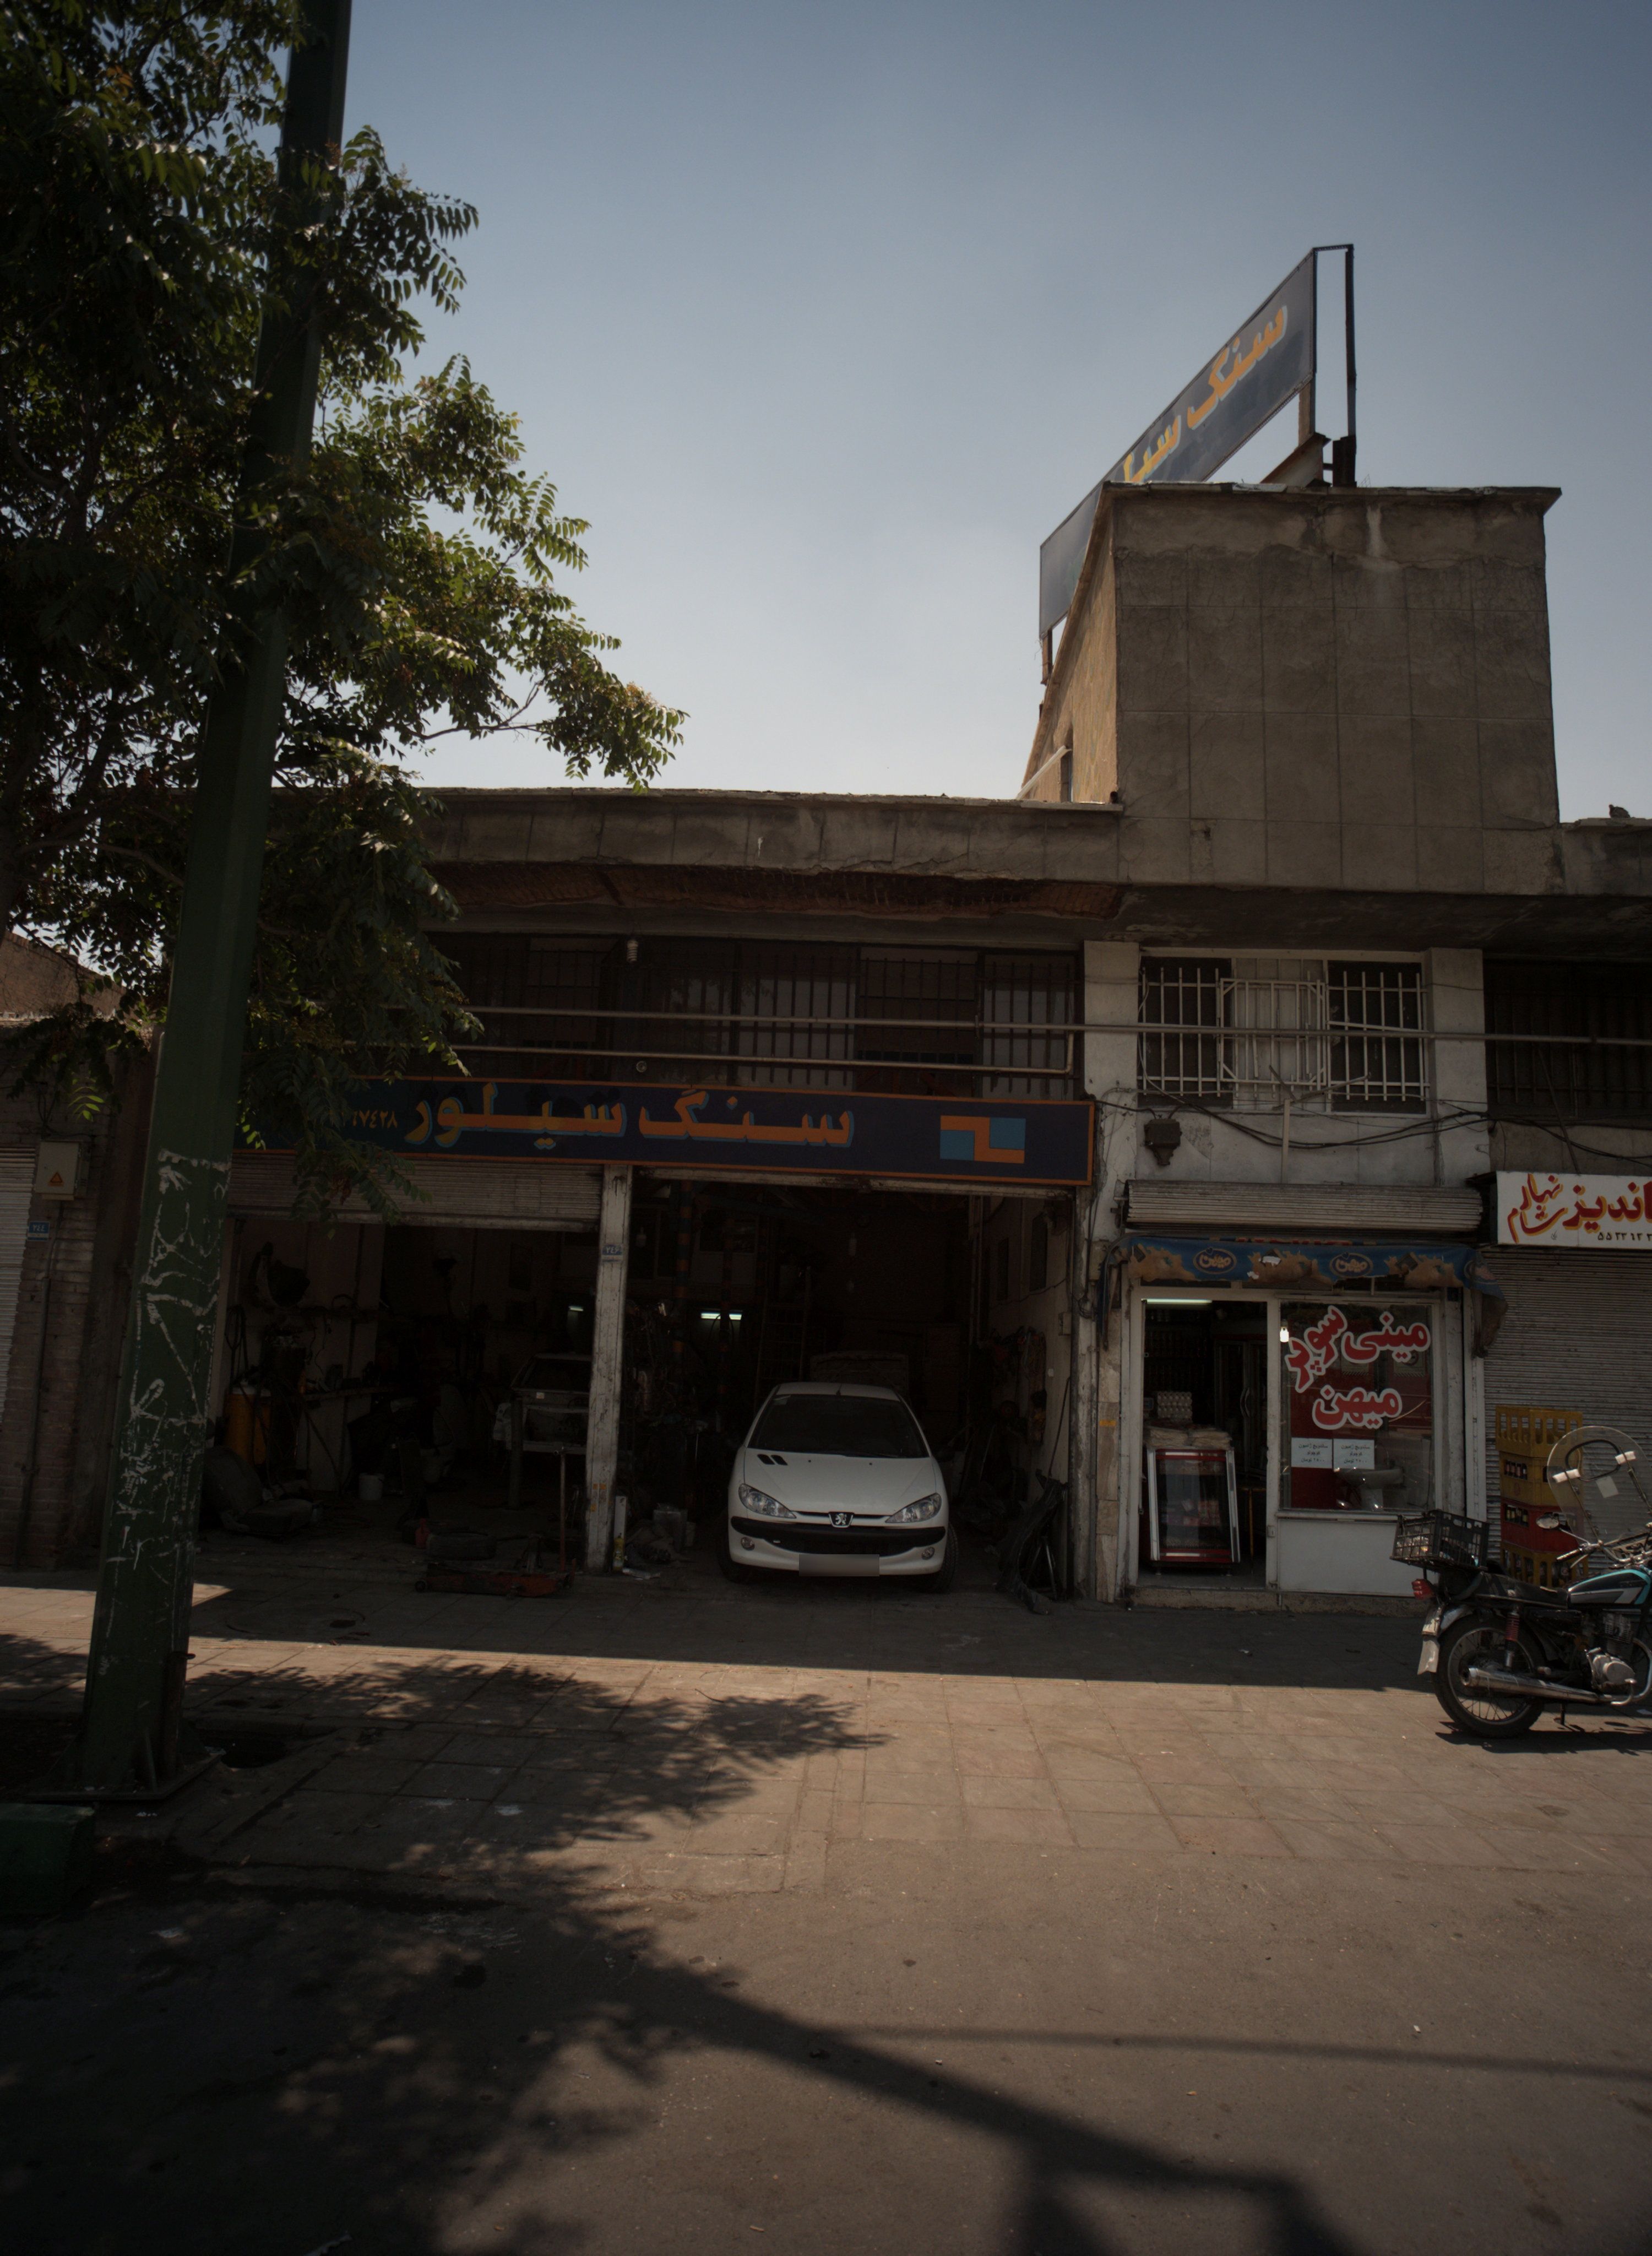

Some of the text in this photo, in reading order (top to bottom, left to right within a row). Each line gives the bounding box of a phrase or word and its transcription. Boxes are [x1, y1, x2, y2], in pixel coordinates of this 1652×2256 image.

[404, 1081, 855, 1149] سنگ سیلور
[1507, 1204, 1568, 1244] شام
[1284, 1304, 1431, 1393] مینی سوپر
[1312, 1384, 1403, 1430] میهن
